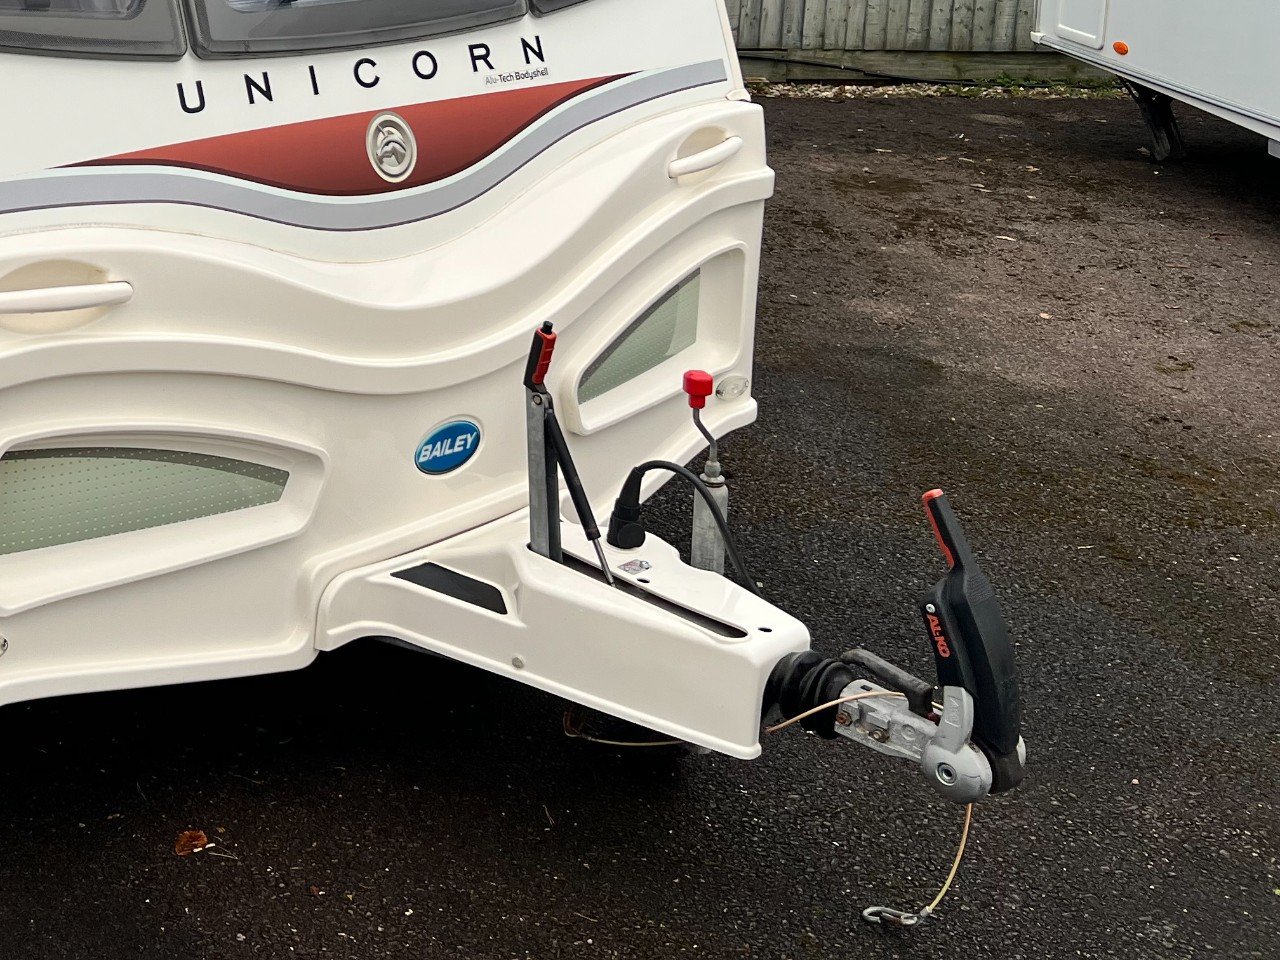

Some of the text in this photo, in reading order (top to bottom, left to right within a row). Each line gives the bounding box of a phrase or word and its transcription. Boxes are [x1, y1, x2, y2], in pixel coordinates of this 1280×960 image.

[176, 35, 546, 114] UNICORN
[485, 67, 549, 85] Alu-Tech Bodyshell
[418, 431, 478, 463] BAILEY
[926, 614, 951, 658] AL-KO
